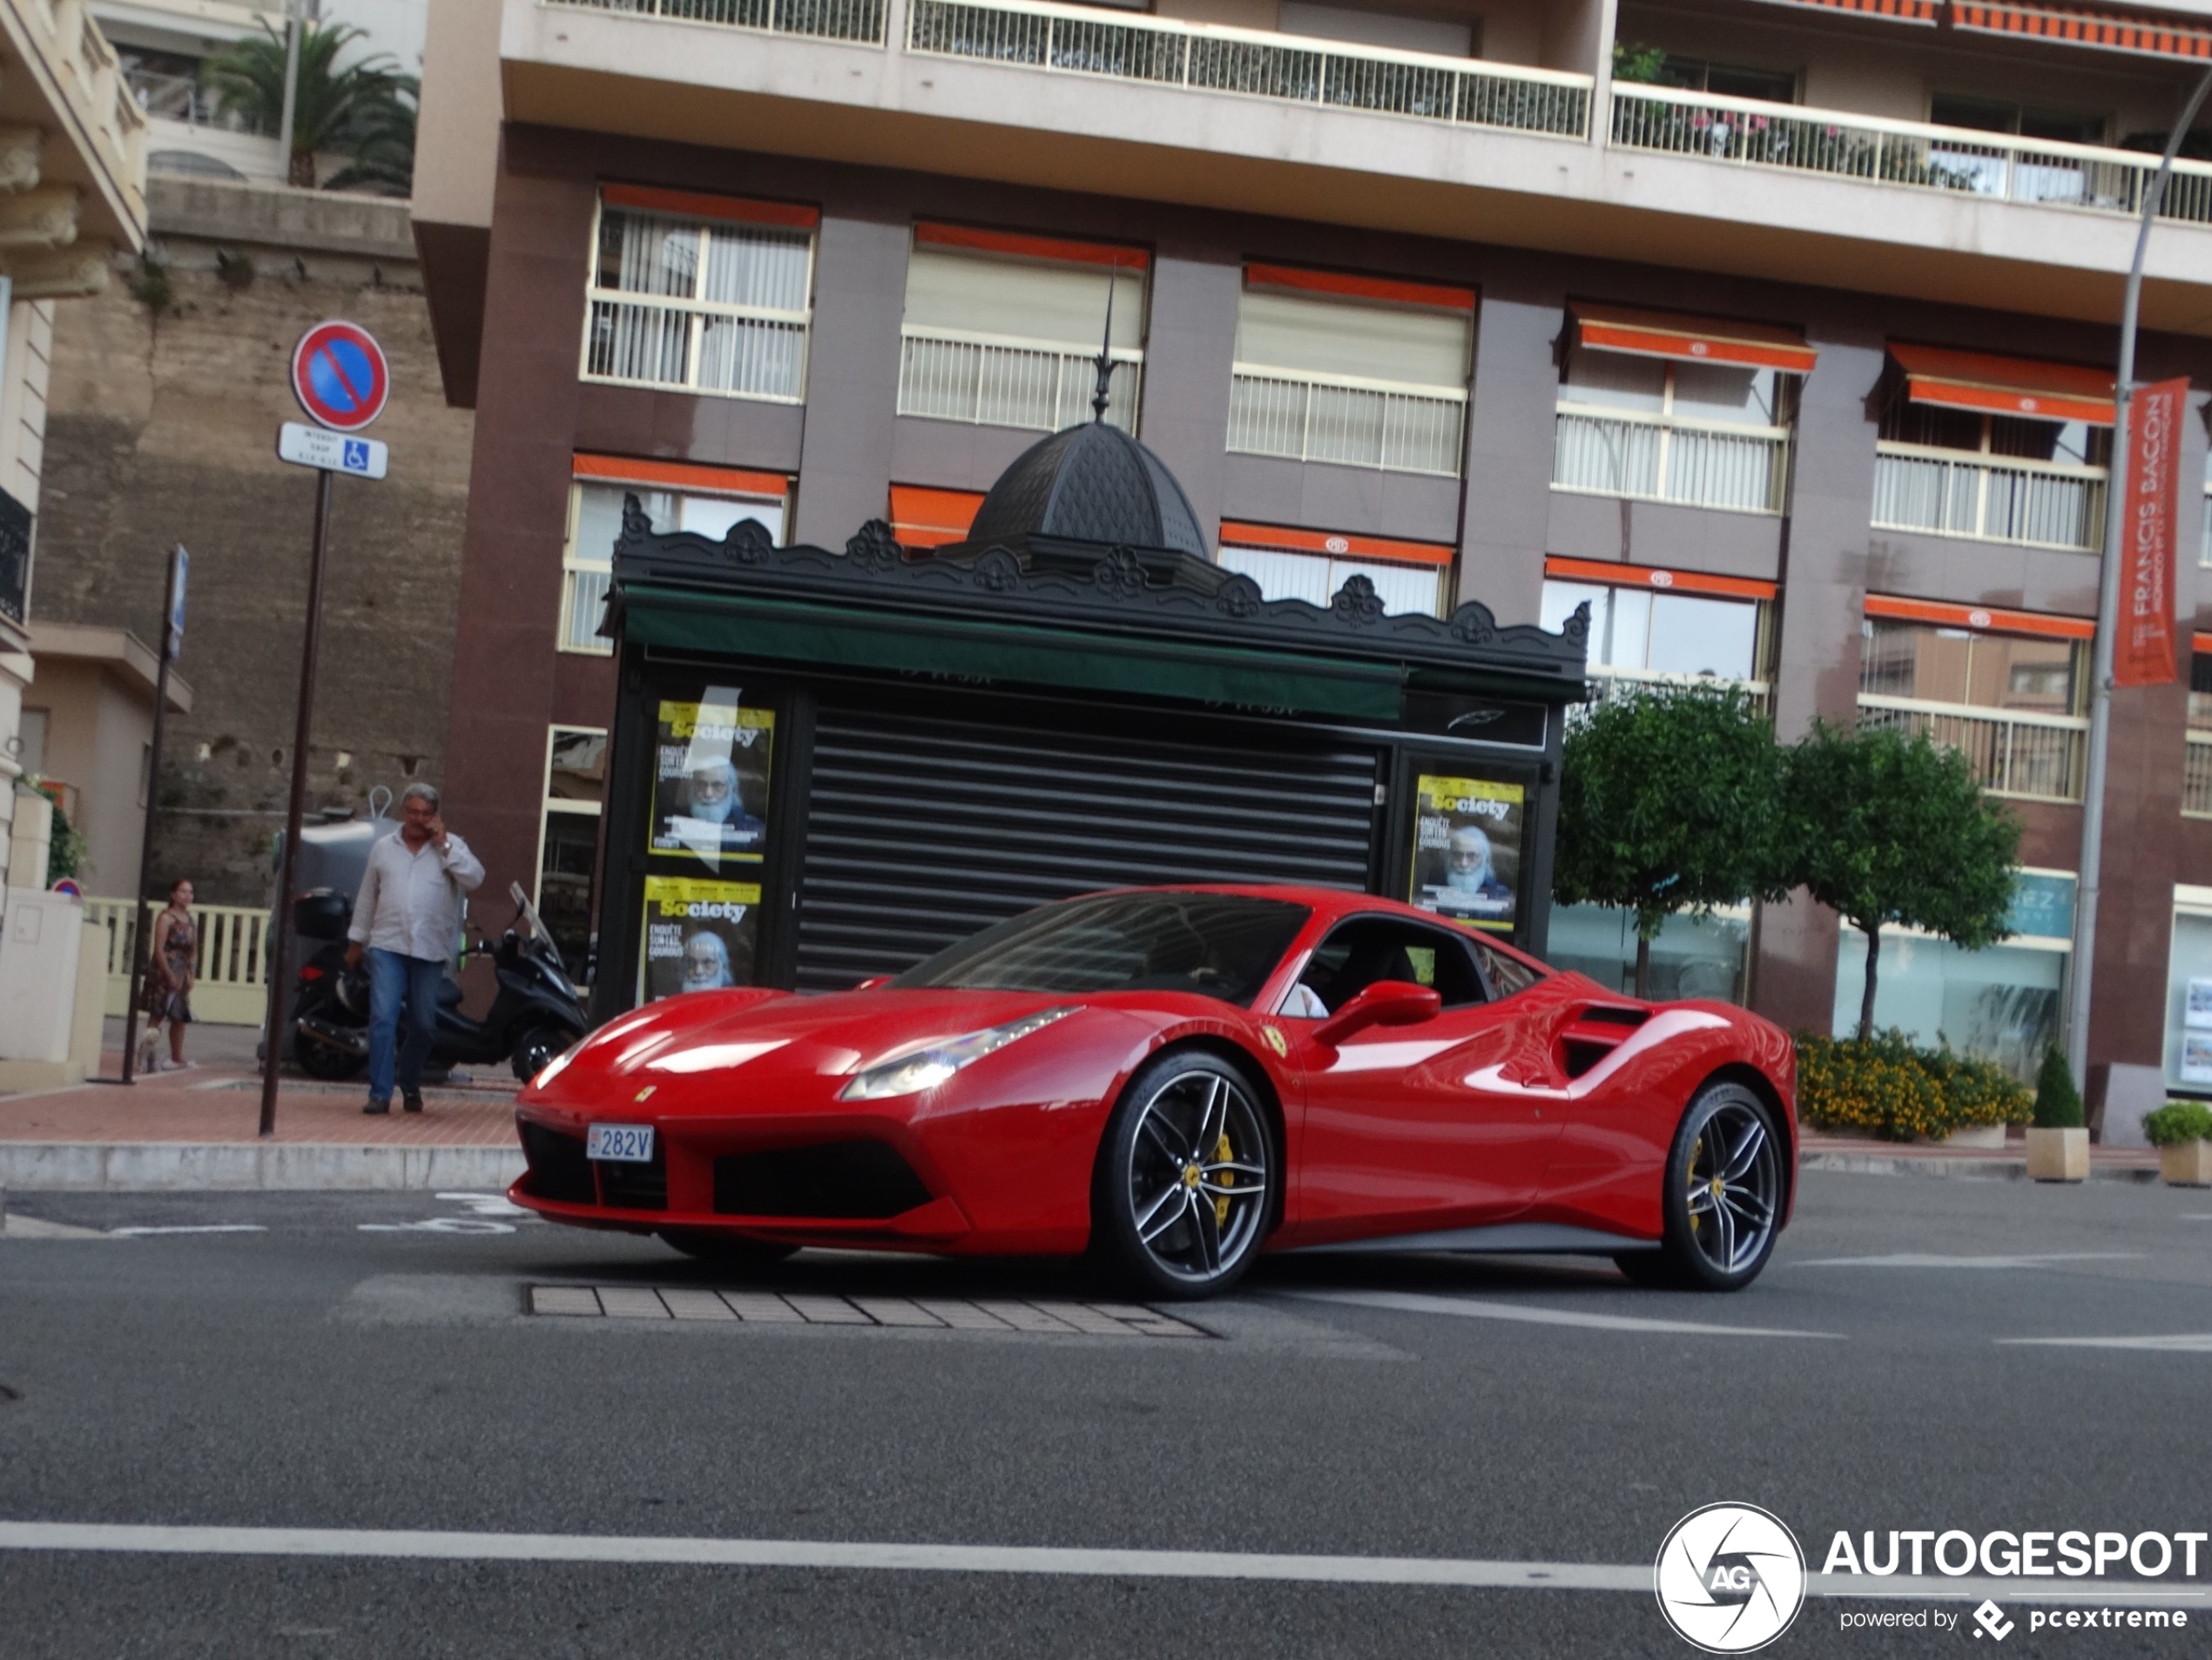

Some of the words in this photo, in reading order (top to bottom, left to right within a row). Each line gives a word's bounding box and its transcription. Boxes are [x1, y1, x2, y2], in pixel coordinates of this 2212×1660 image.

[2141, 394, 2162, 495] BACON
[2134, 503, 2155, 617] FRANCIS
[671, 719, 759, 749] Society
[1430, 793, 1510, 821] Society
[659, 899, 747, 925] Society
[602, 1130, 649, 1157] 282V
